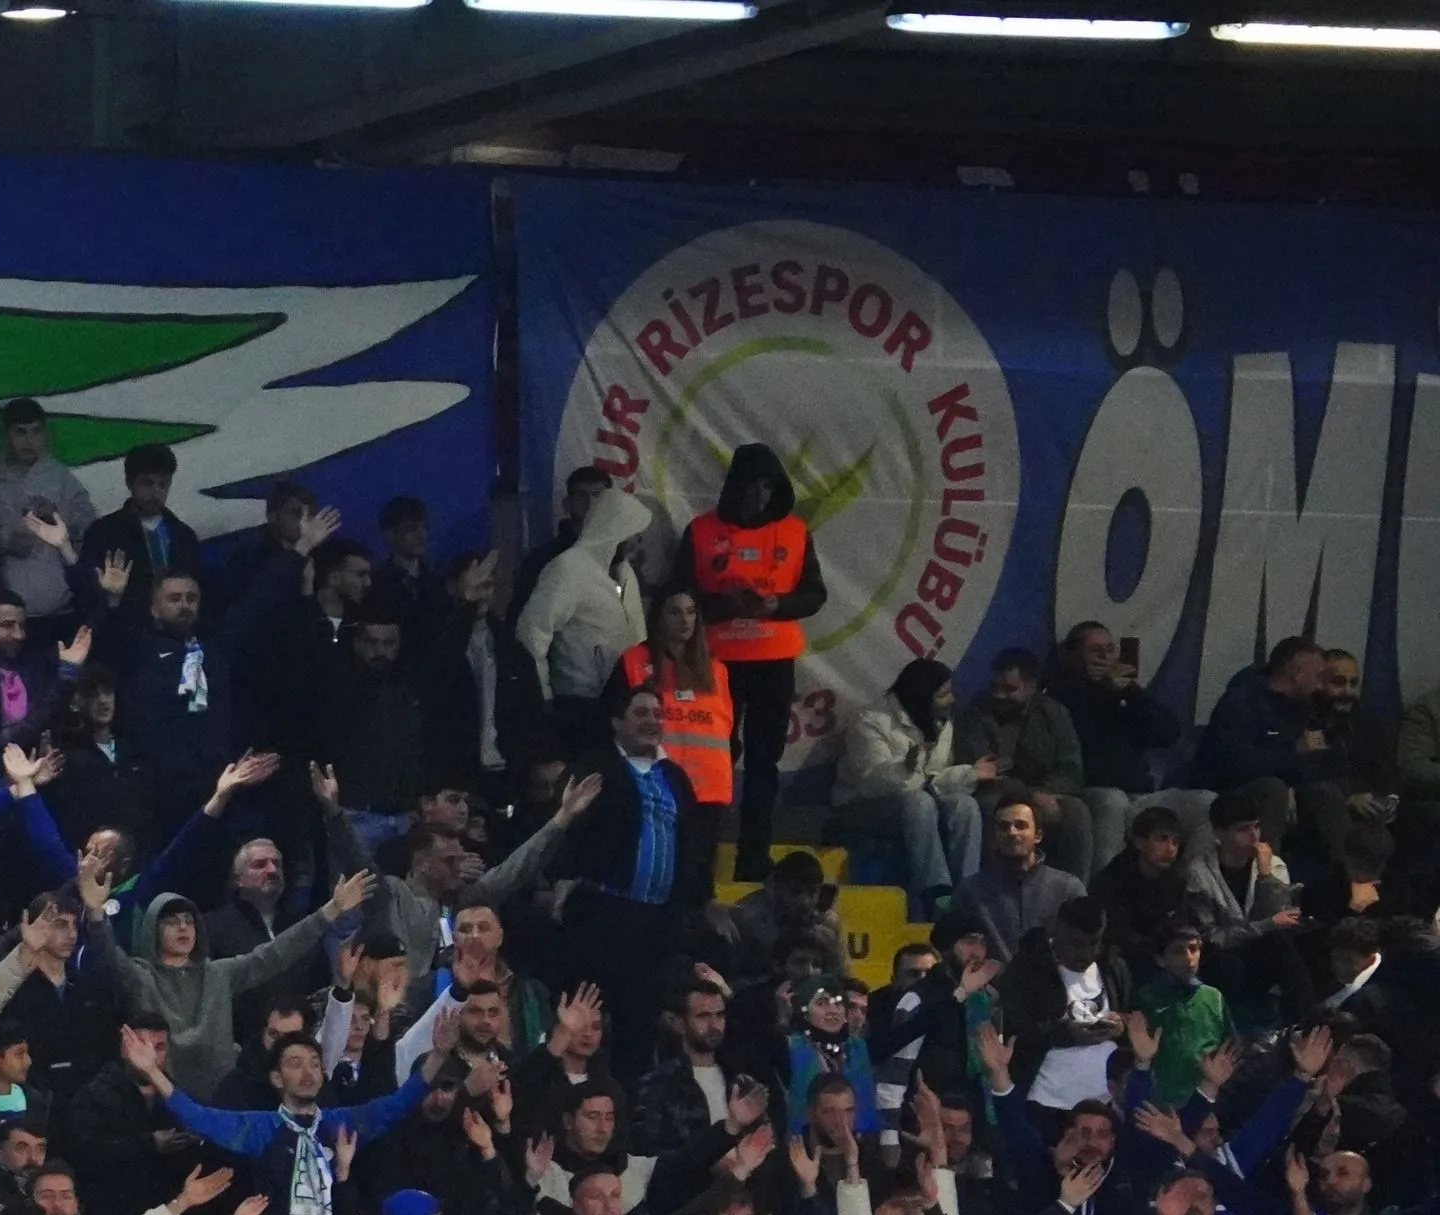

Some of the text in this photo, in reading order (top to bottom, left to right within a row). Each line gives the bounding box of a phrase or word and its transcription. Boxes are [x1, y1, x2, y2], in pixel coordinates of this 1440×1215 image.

[635, 258, 989, 660] RİZESPOR KULÜBÜ
[1054, 266, 1440, 727] ÖM
[847, 932, 869, 959] U
